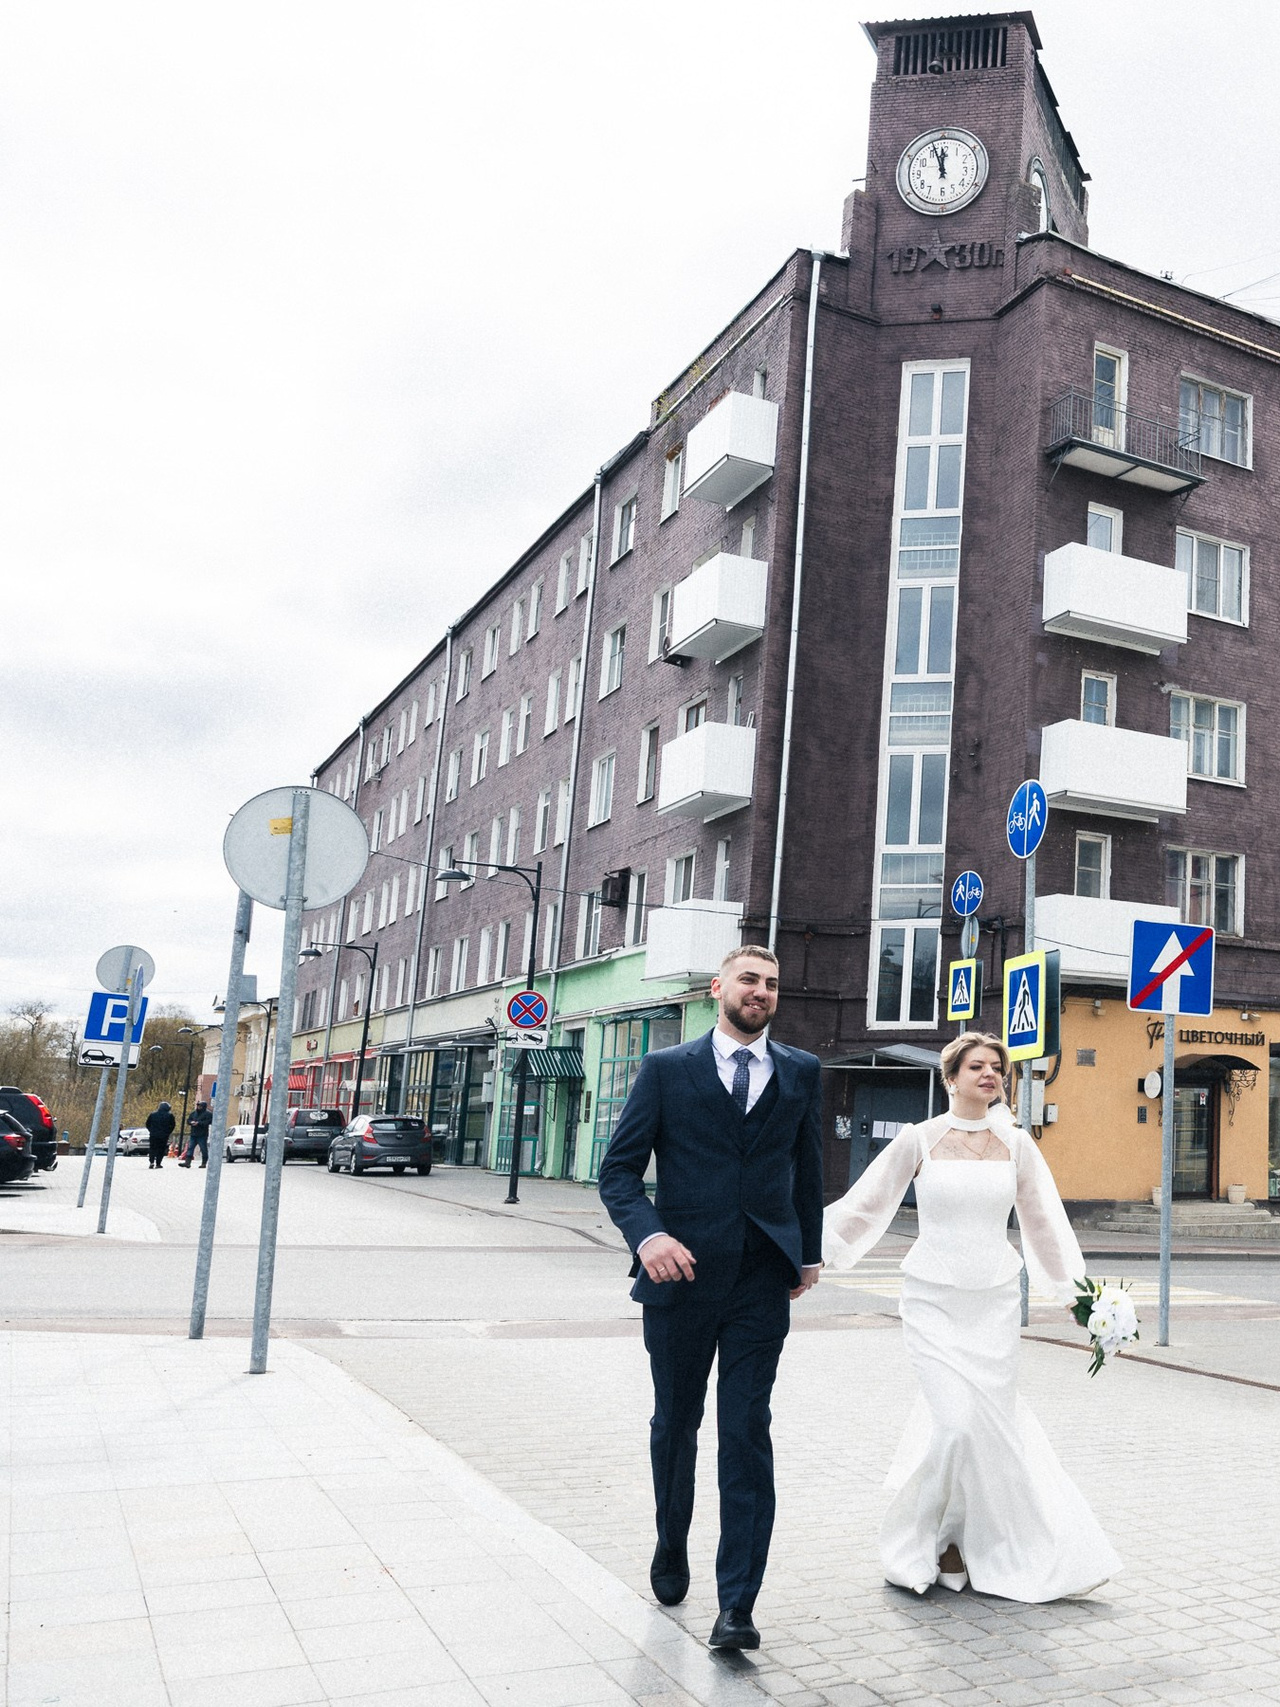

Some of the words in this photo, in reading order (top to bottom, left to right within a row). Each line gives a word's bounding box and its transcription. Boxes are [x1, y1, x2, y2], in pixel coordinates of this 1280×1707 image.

[920, 158, 927, 168] 10
[962, 154, 968, 164] 2
[916, 169, 922, 179] 9
[962, 166, 968, 176] 3
[920, 179, 925, 189] 8
[958, 178, 965, 187] 4
[927, 185, 932, 195] 7
[940, 187, 945, 197] 6
[950, 184, 956, 194] 5
[101, 998, 131, 1036] P
[1179, 1029, 1266, 1047] ЦВЕТОЧНЫЙ
